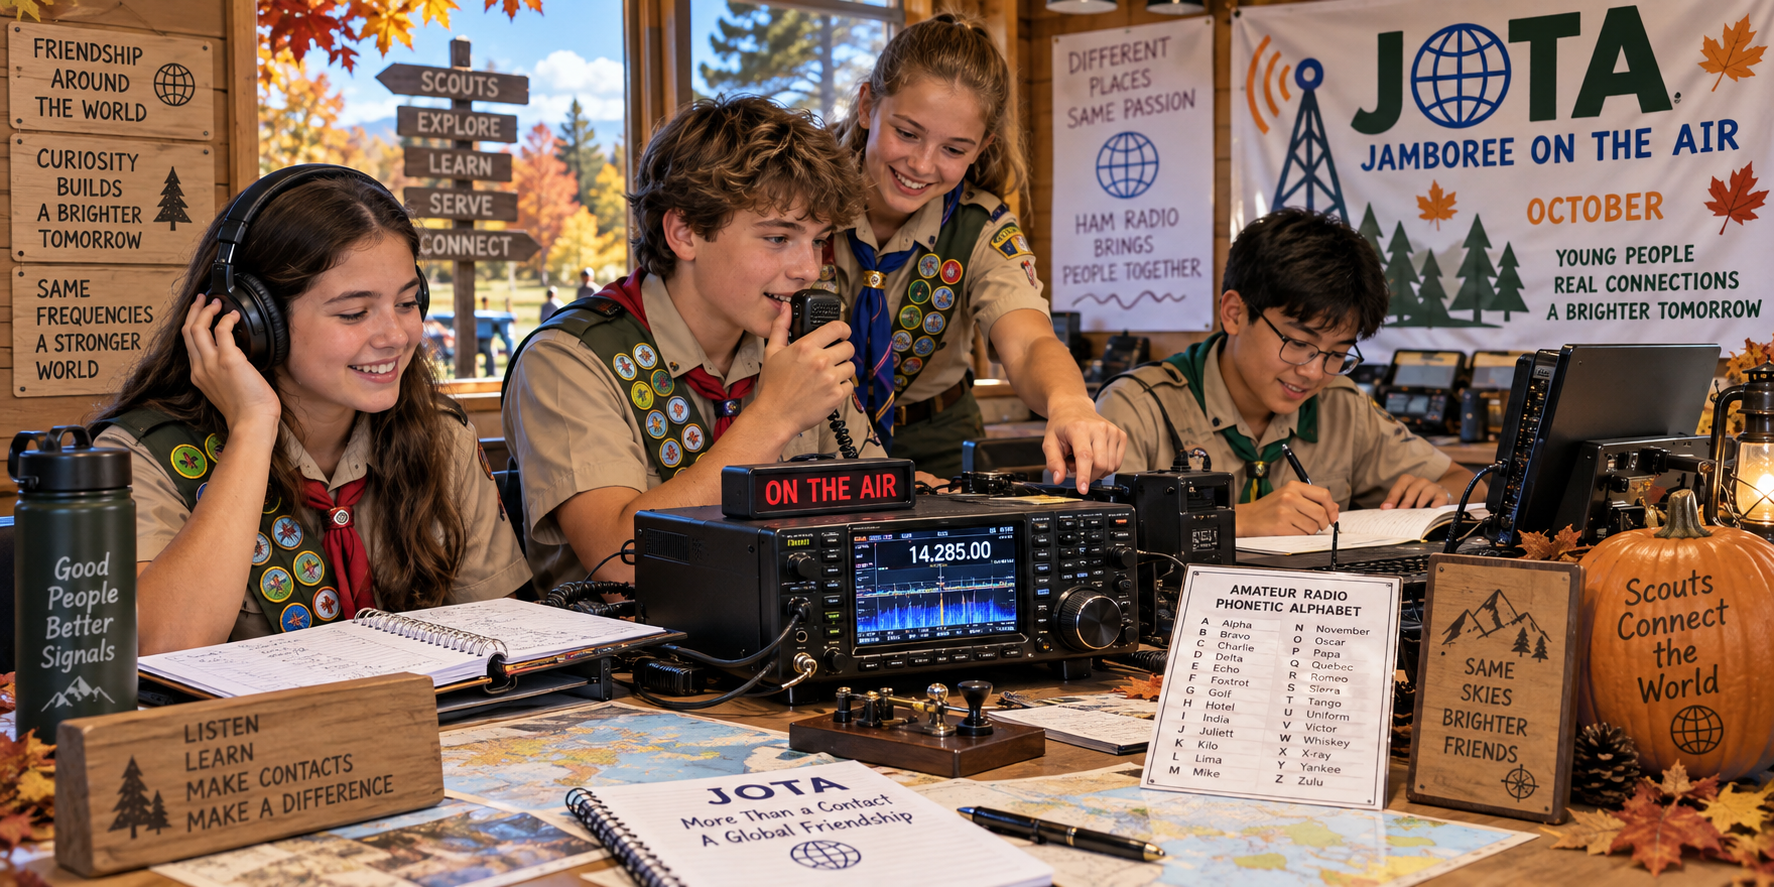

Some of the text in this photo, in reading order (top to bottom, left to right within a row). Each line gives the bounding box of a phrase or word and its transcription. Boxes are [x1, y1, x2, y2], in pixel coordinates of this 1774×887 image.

[34, 37, 143, 66] FRIENDSHIP
[1068, 36, 1171, 74] DIFFERENT
[50, 68, 130, 93] AROUND
[421, 71, 499, 98] SCOUTS
[1090, 71, 1151, 96] PLACES
[35, 97, 147, 122] THE WORLD
[1067, 88, 1196, 128] SAME PASSION
[417, 112, 500, 138] EXPLORE
[1361, 119, 1739, 172] JAMBOREE ON THE AIR
[36, 148, 139, 172] CURIOSITY
[429, 154, 492, 176] LEARN
[57, 177, 123, 197] BUILDS
[37, 203, 142, 224] A BRIGHTER
[430, 195, 493, 216] SERVE
[1527, 191, 1664, 225] OCTOBER
[1075, 208, 1179, 234] HAM RADIO
[38, 229, 142, 250] TOMORROW
[420, 234, 511, 257] CONNECT
[1094, 235, 1154, 256] BRINGS
[1556, 244, 1694, 267] YOUNG PEOPLE
[1063, 259, 1202, 285] PEOPLE TOGETHER
[1554, 271, 1740, 294] REAL CONNECTIONS
[37, 279, 91, 299] SAME
[37, 305, 153, 326] FREQUENCIES
[1546, 299, 1762, 321] A BRIGHTER TOMORROW
[36, 332, 141, 353] A STRONGER
[36, 360, 100, 380] WORLD
[765, 473, 896, 505] ON THE AIR
[909, 541, 991, 563] 14.285.00
[54, 552, 110, 582] Good
[47, 581, 119, 614] People
[1230, 584, 1348, 601] AMATEUR RADIO
[1625, 570, 1714, 606] Scouts
[1216, 599, 1361, 617] PHONETIC ALPHABET
[46, 614, 114, 639] Better
[1222, 620, 1252, 631] Alpha
[1617, 598, 1729, 640] Connect
[1220, 630, 1250, 641] Bravo
[1295, 624, 1370, 636] N November
[1197, 639, 1254, 652] C Charlie
[1293, 636, 1345, 647] O Oscar
[41, 638, 115, 673] Signals
[1194, 651, 1243, 663] D Delta
[1292, 647, 1341, 660] P Papa
[1653, 638, 1698, 669] the
[1192, 662, 1240, 674] E Echo
[1290, 659, 1354, 672] Q Quebec
[1464, 658, 1515, 679] SAME
[1189, 674, 1249, 687] F Foxtrot
[1287, 683, 1295, 692] S
[1289, 671, 1348, 683] R Romeo
[1637, 664, 1719, 703] World
[1186, 686, 1232, 698] G Golf
[1286, 696, 1341, 709] T Tango
[1461, 683, 1513, 706] SKIES
[1183, 699, 1235, 711] H Hotel
[1284, 708, 1350, 722] U Uniform
[184, 714, 259, 744] LISTEN
[1203, 713, 1230, 724] India
[1283, 721, 1337, 733] V Victor
[1442, 708, 1528, 737] BRIGHTER
[1178, 725, 1234, 738] J Juliett
[1279, 734, 1350, 748] W Whiskey
[1175, 738, 1218, 750] K Kilo
[1278, 747, 1331, 761] X X-ray
[1444, 736, 1518, 764] FRIENDS
[185, 743, 254, 772] LEARN
[1173, 752, 1222, 764] L Lima
[1277, 761, 1341, 774] Y Yankee
[186, 753, 353, 802] MAKE CONTACTS
[1169, 766, 1220, 778] M Mike
[1275, 775, 1323, 787] Z Zulu
[707, 776, 850, 805] JOTA
[186, 775, 394, 833] MAKE A DIFFERENCE
[681, 794, 893, 830] More Than a Contact
[701, 810, 913, 847] A Global Friendship
